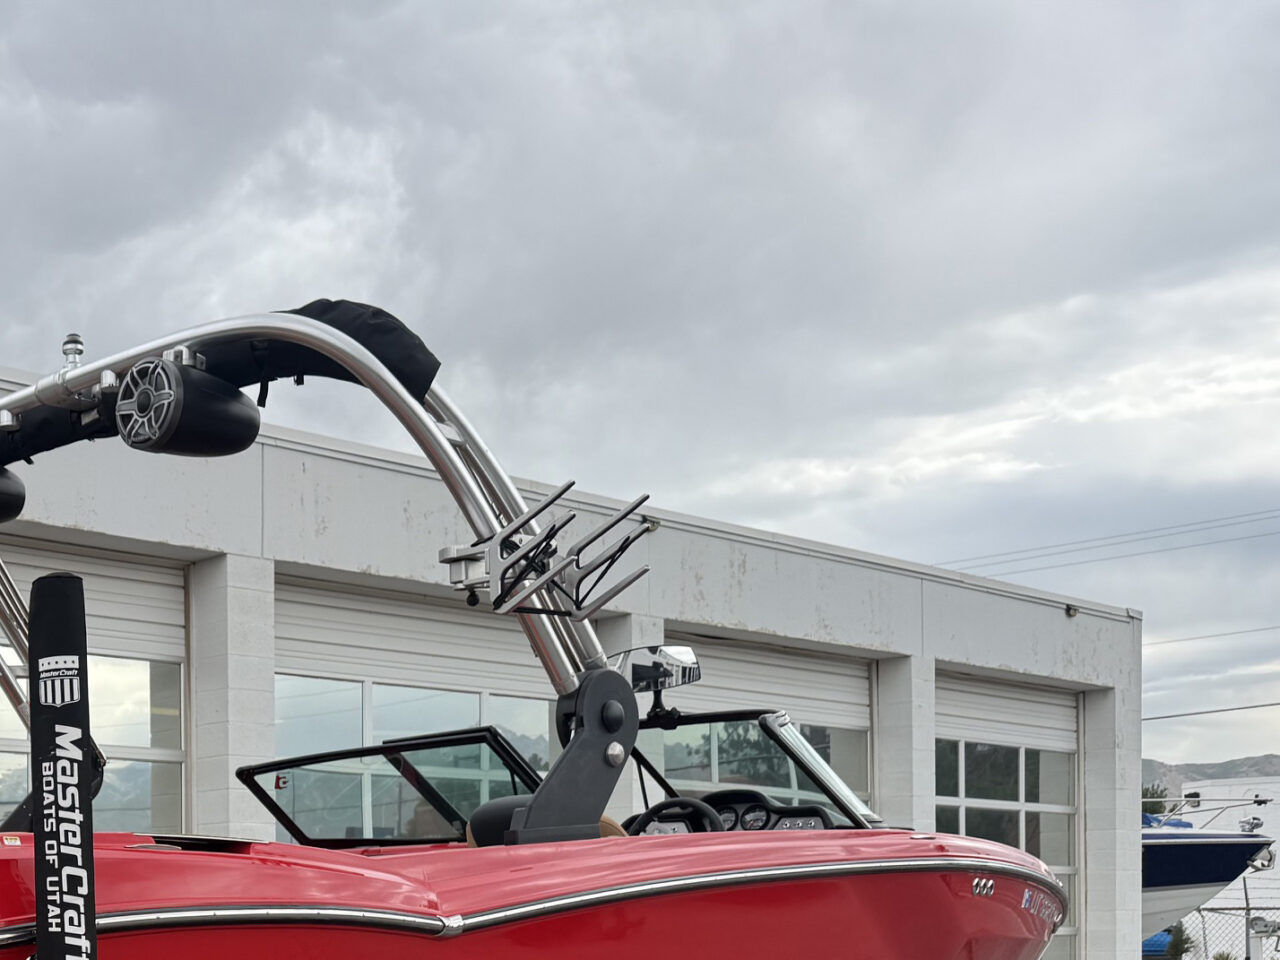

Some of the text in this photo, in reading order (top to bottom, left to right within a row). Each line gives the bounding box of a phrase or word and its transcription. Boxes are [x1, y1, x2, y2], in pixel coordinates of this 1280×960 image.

[42, 762, 61, 932] BOATS OF UTAH
